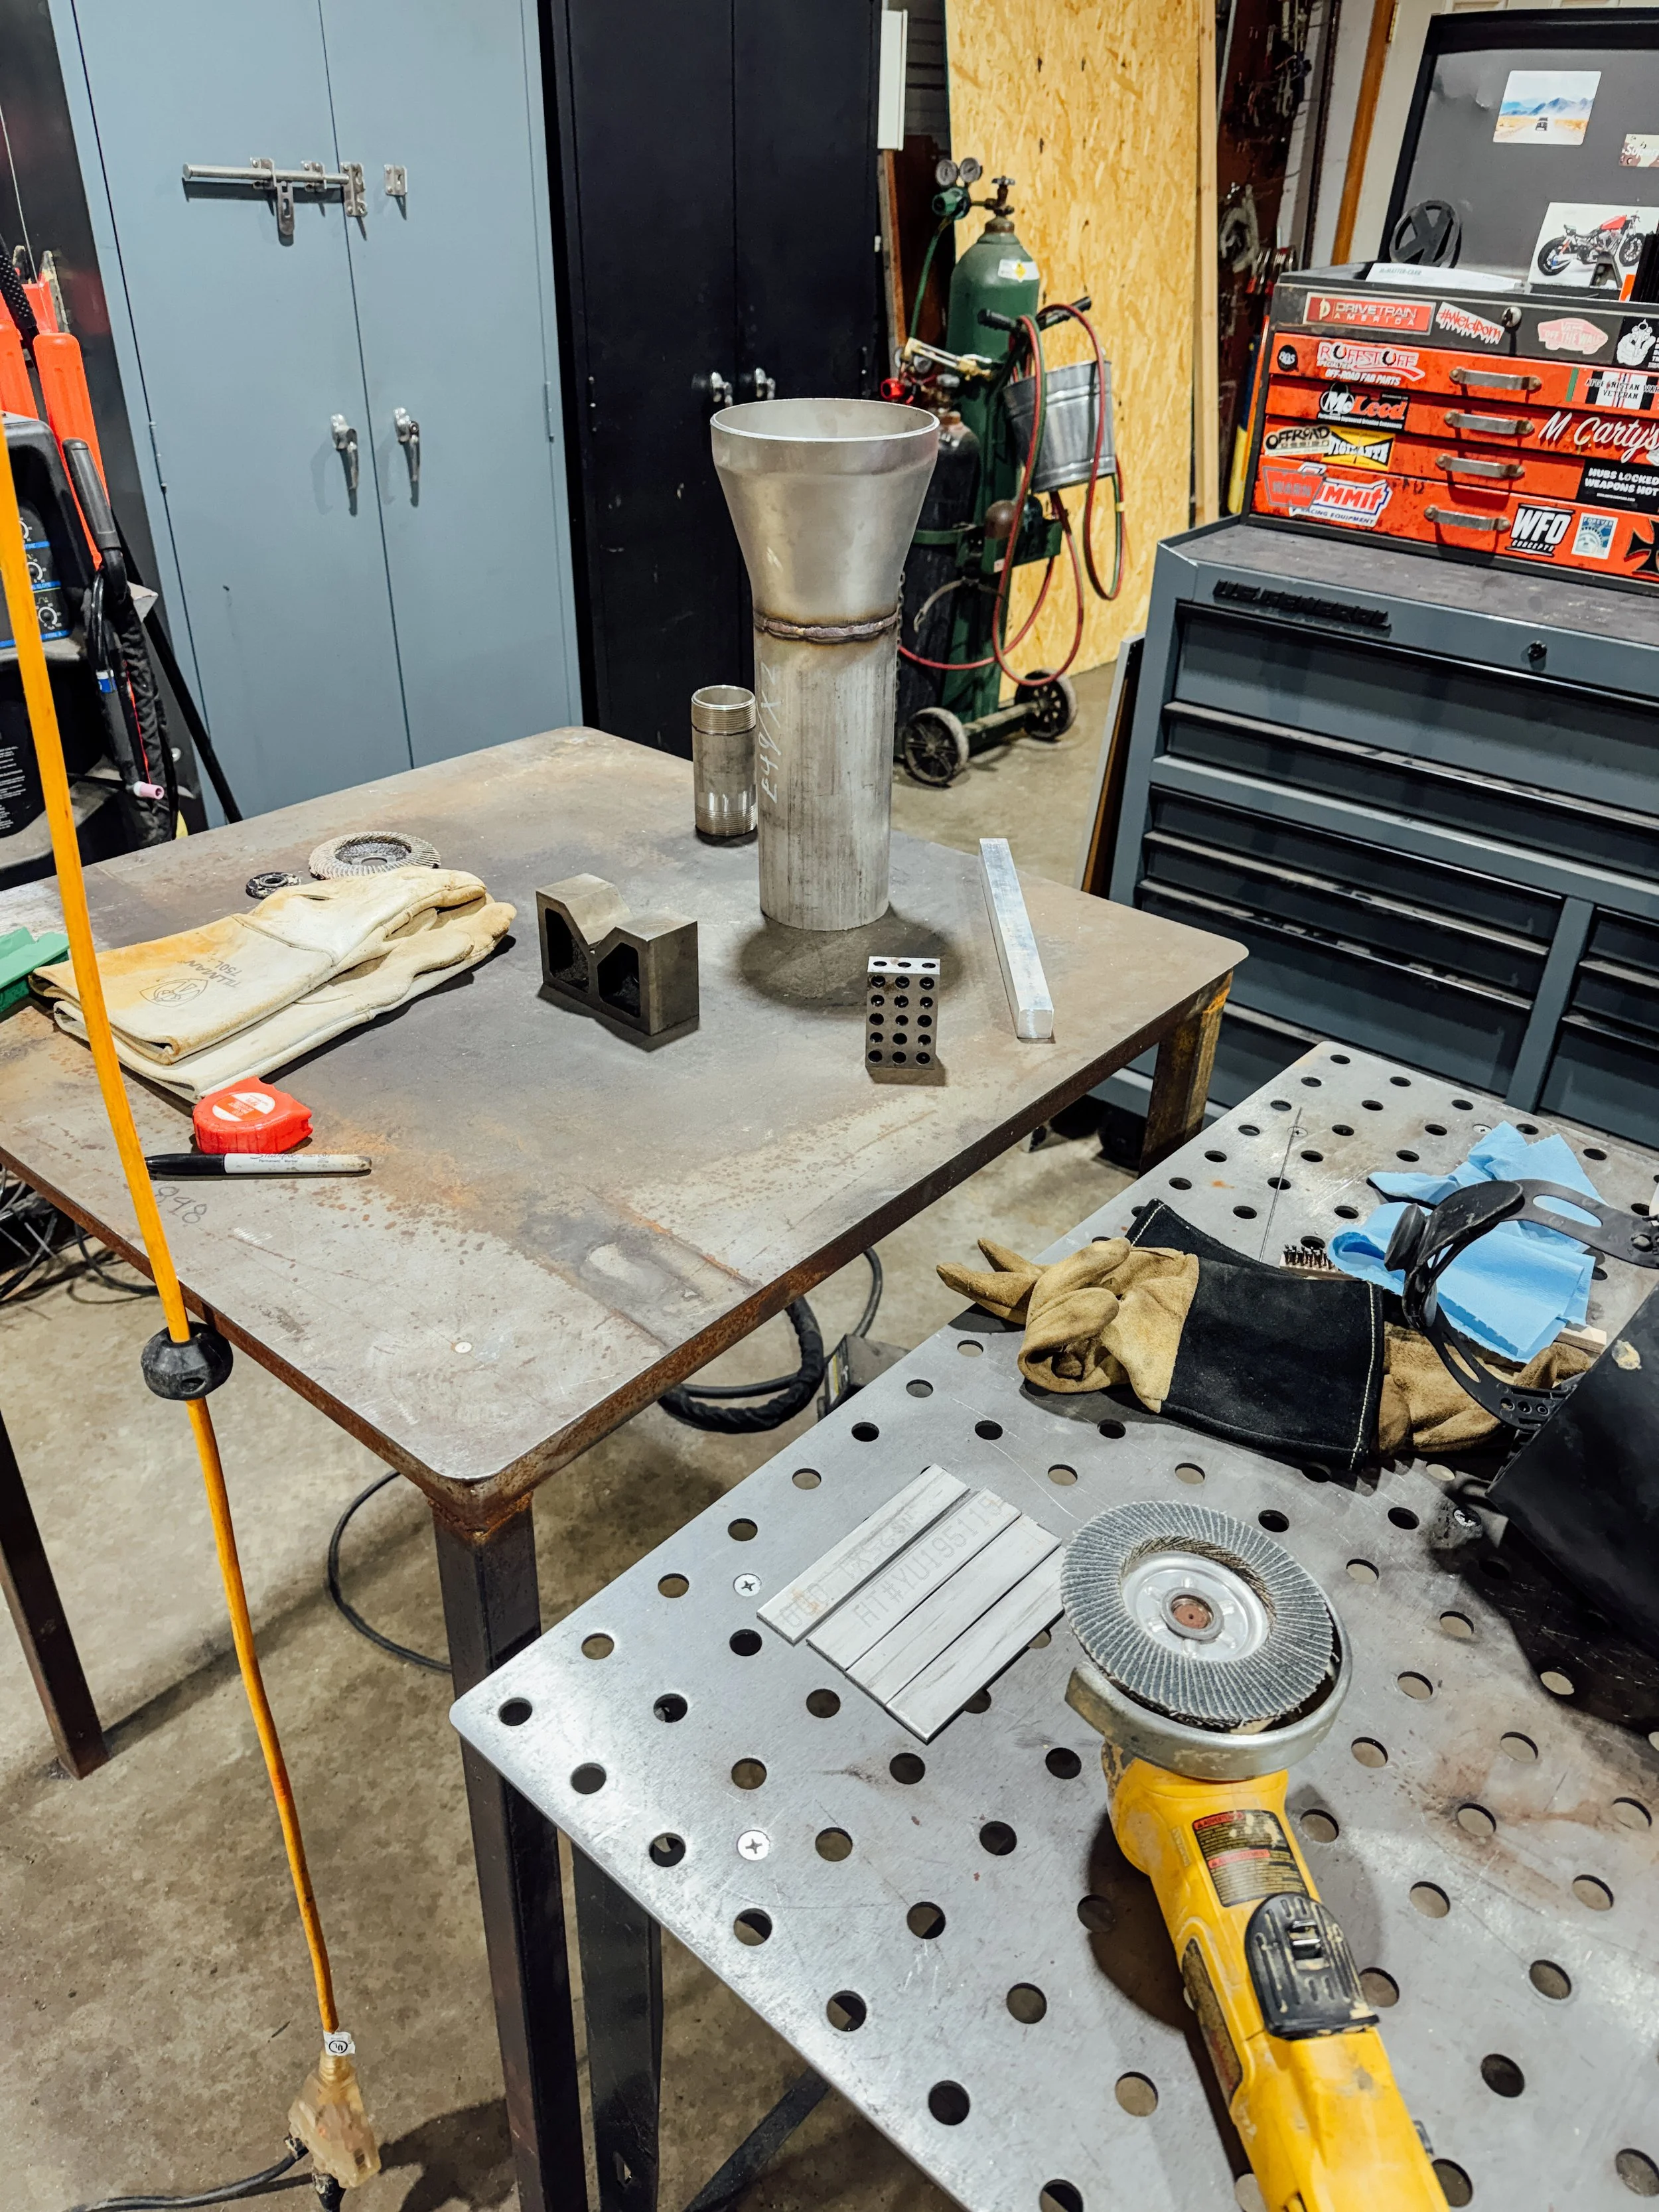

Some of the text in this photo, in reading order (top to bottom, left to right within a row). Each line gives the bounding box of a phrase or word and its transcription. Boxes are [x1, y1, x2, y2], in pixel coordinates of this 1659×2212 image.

[1335, 302, 1417, 319] DRIVETRAIN
[1334, 313, 1414, 326] AMERICA
[1325, 369, 1360, 382] OFF-ROAD
[1375, 374, 1401, 386] PARTS
[1603, 390, 1638, 399] VETERAN
[1588, 467, 1659, 485] HUBS LOCKED
[1585, 477, 1659, 496] WEAPONS HOT
[1330, 512, 1374, 524] EQUIPMENT
[1583, 516, 1613, 526] FOREVER
[1510, 508, 1571, 545] WFO
[1512, 540, 1555, 552] CONCEPTS
